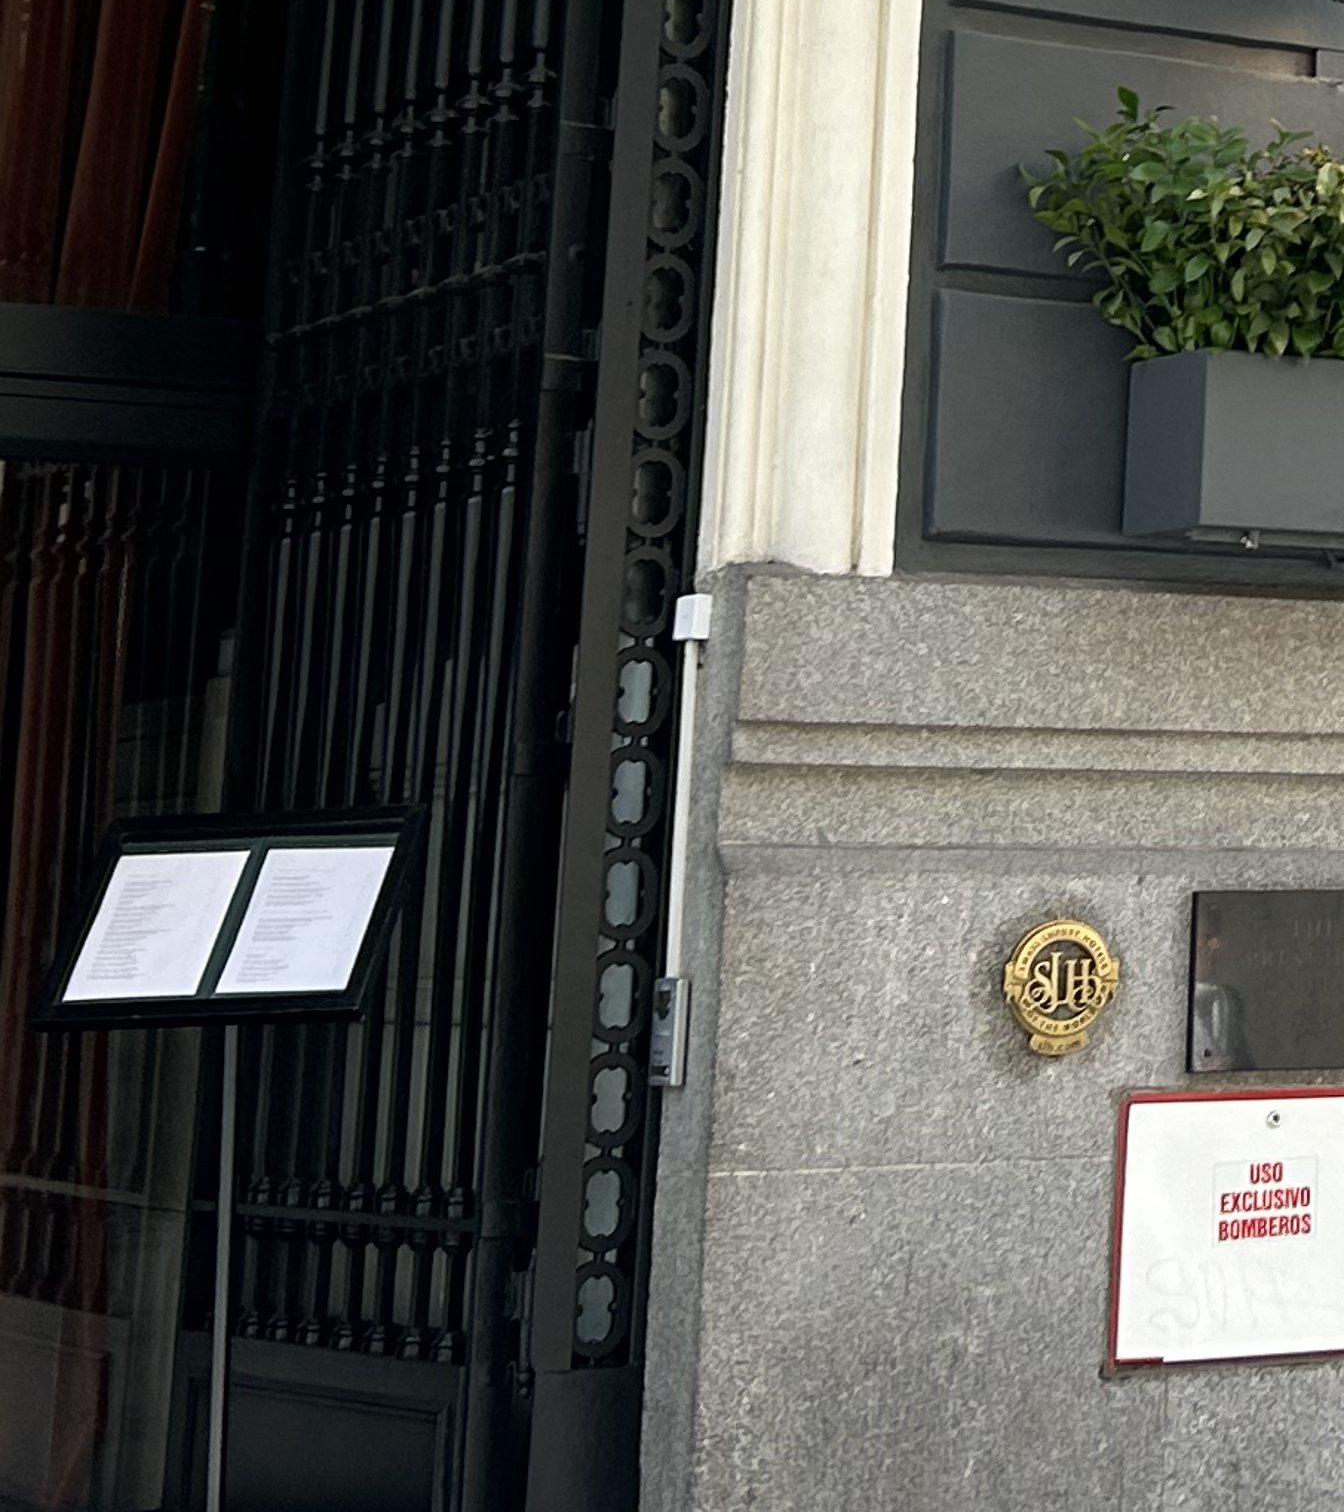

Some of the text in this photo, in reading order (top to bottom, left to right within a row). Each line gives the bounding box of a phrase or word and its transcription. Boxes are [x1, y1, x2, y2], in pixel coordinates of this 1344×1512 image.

[1249, 1161, 1284, 1185] USO
[1220, 1186, 1311, 1215] EXCLUSIVO
[1218, 1213, 1311, 1243] BOMBEROS
